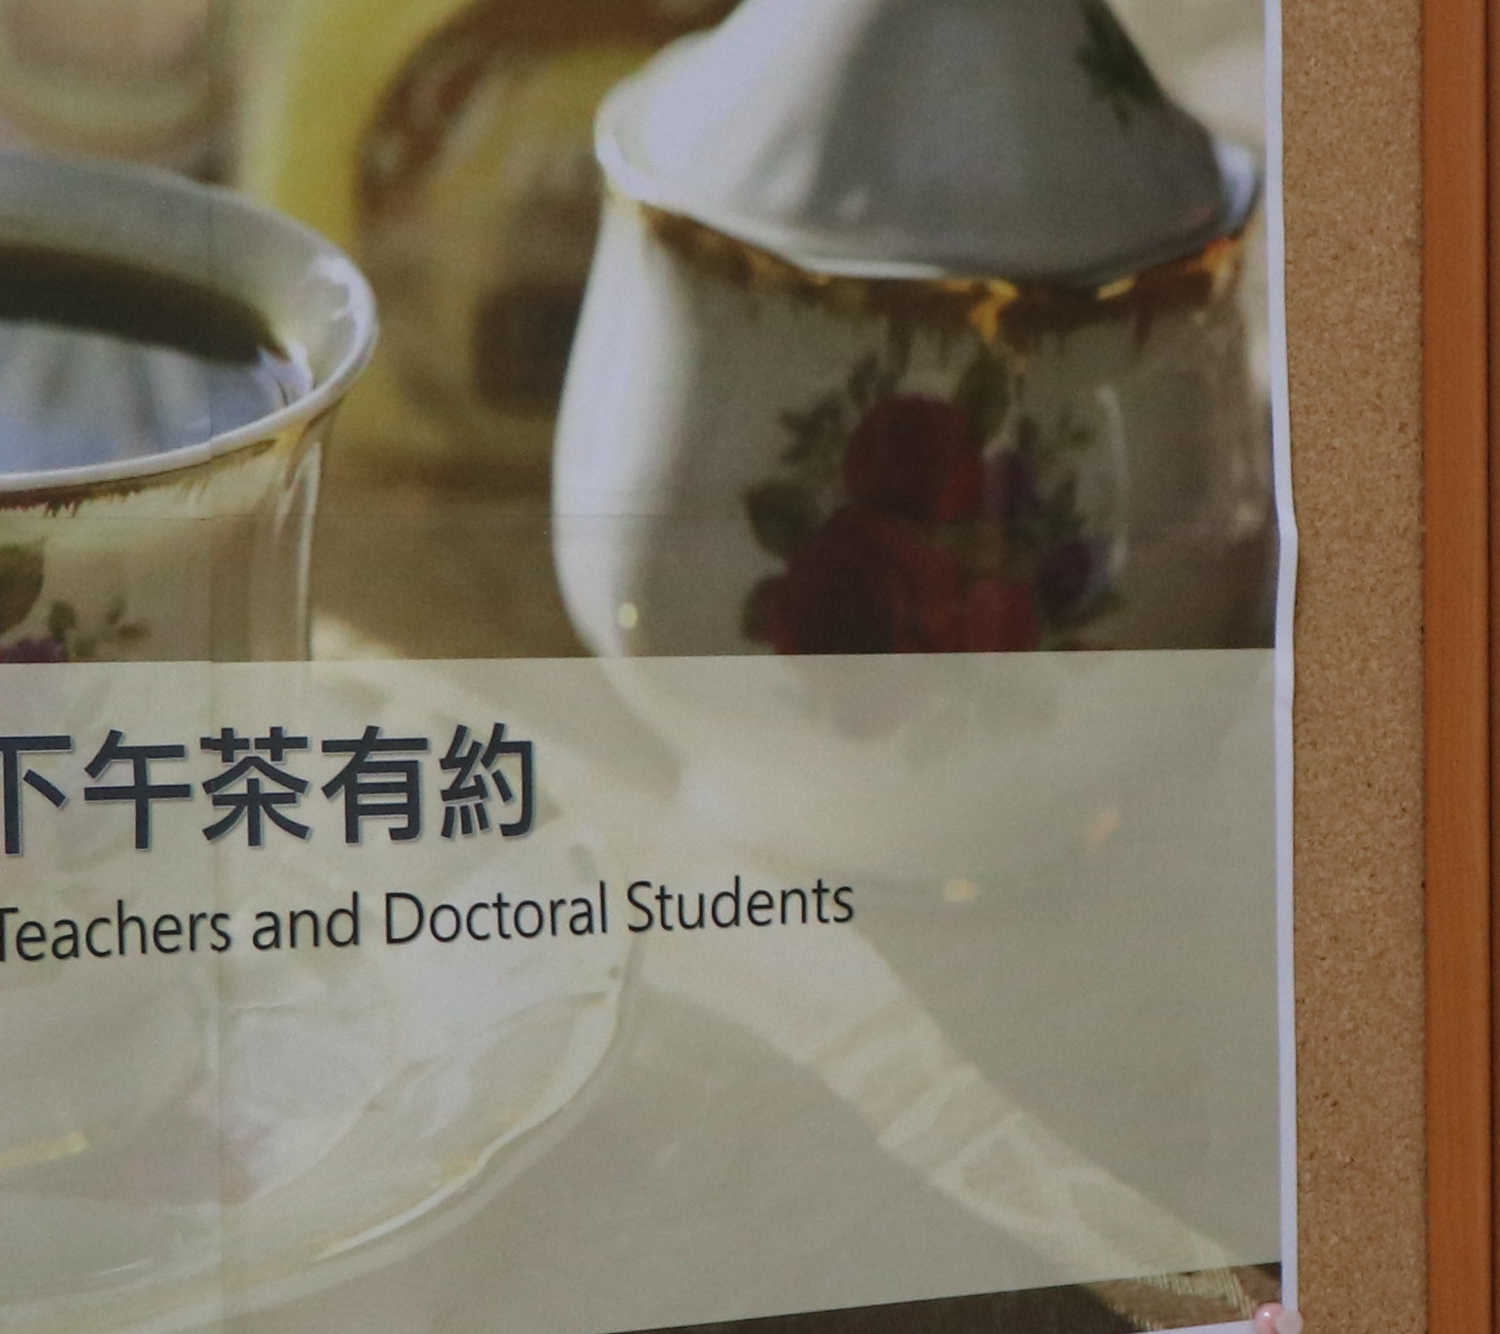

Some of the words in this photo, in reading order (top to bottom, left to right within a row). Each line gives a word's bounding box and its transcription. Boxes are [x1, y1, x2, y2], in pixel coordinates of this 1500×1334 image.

[252, 890, 360, 951] and
[385, 880, 608, 945] Doctoral
[626, 874, 855, 934] Students
